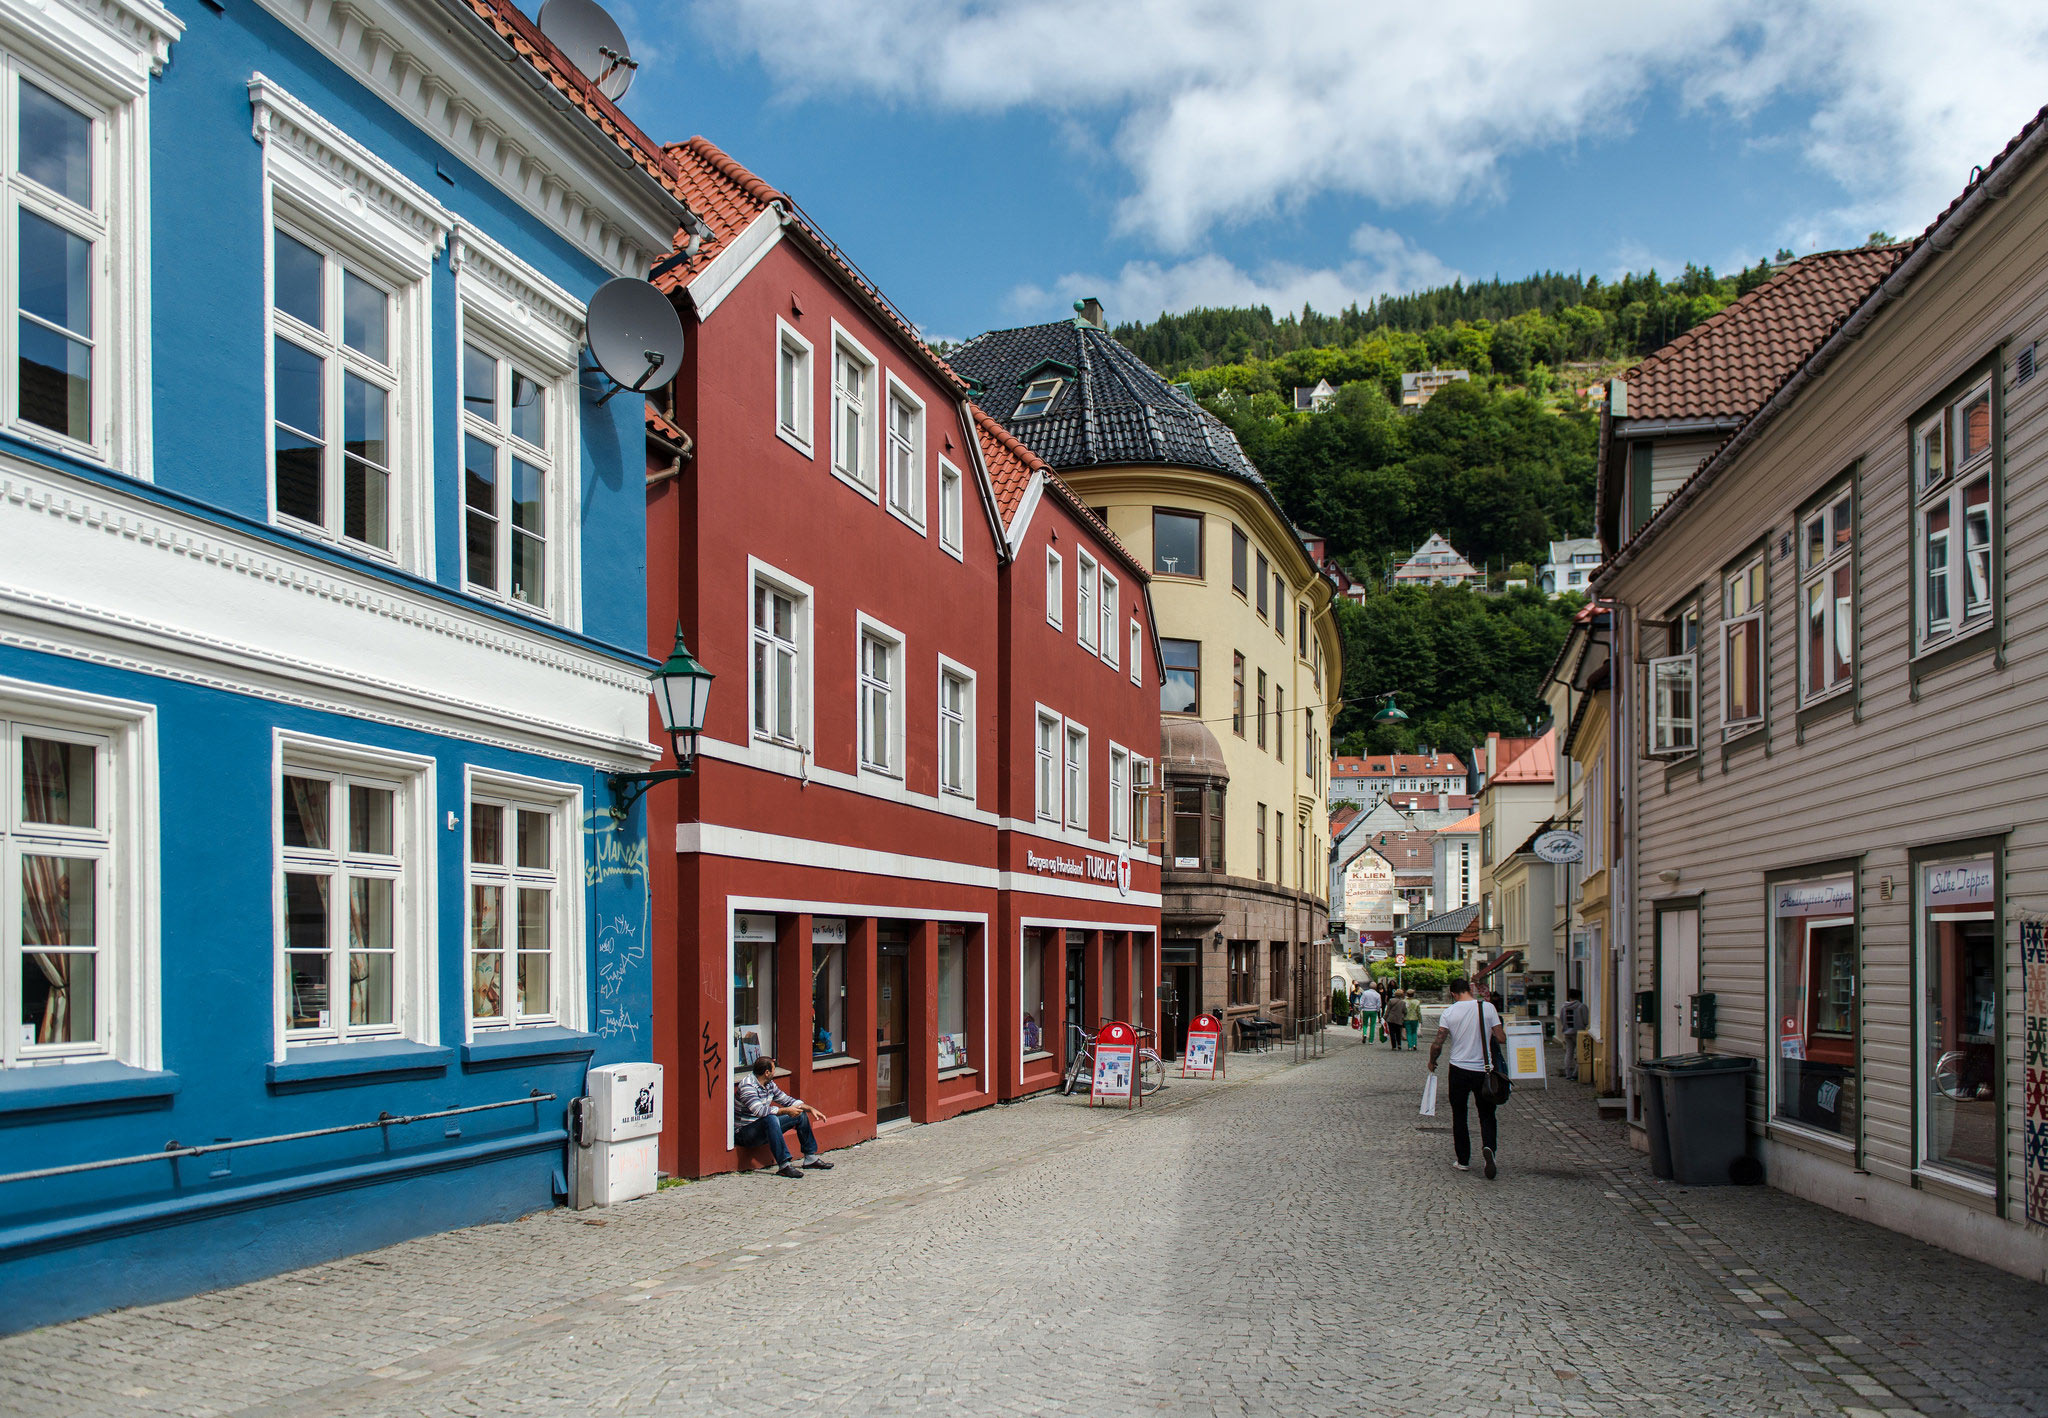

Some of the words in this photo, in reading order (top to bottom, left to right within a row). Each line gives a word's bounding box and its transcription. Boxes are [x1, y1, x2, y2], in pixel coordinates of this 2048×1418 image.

[1027, 850, 1049, 872] Bergen
[1049, 859, 1057, 874] og
[1056, 856, 1084, 876] Hordaland
[1085, 855, 1117, 881] TURLAG
[1932, 870, 1955, 894] Silke
[1957, 868, 1990, 897] Tepper
[1825, 887, 1852, 909] Tepper
[1114, 1029, 1121, 1037] T
